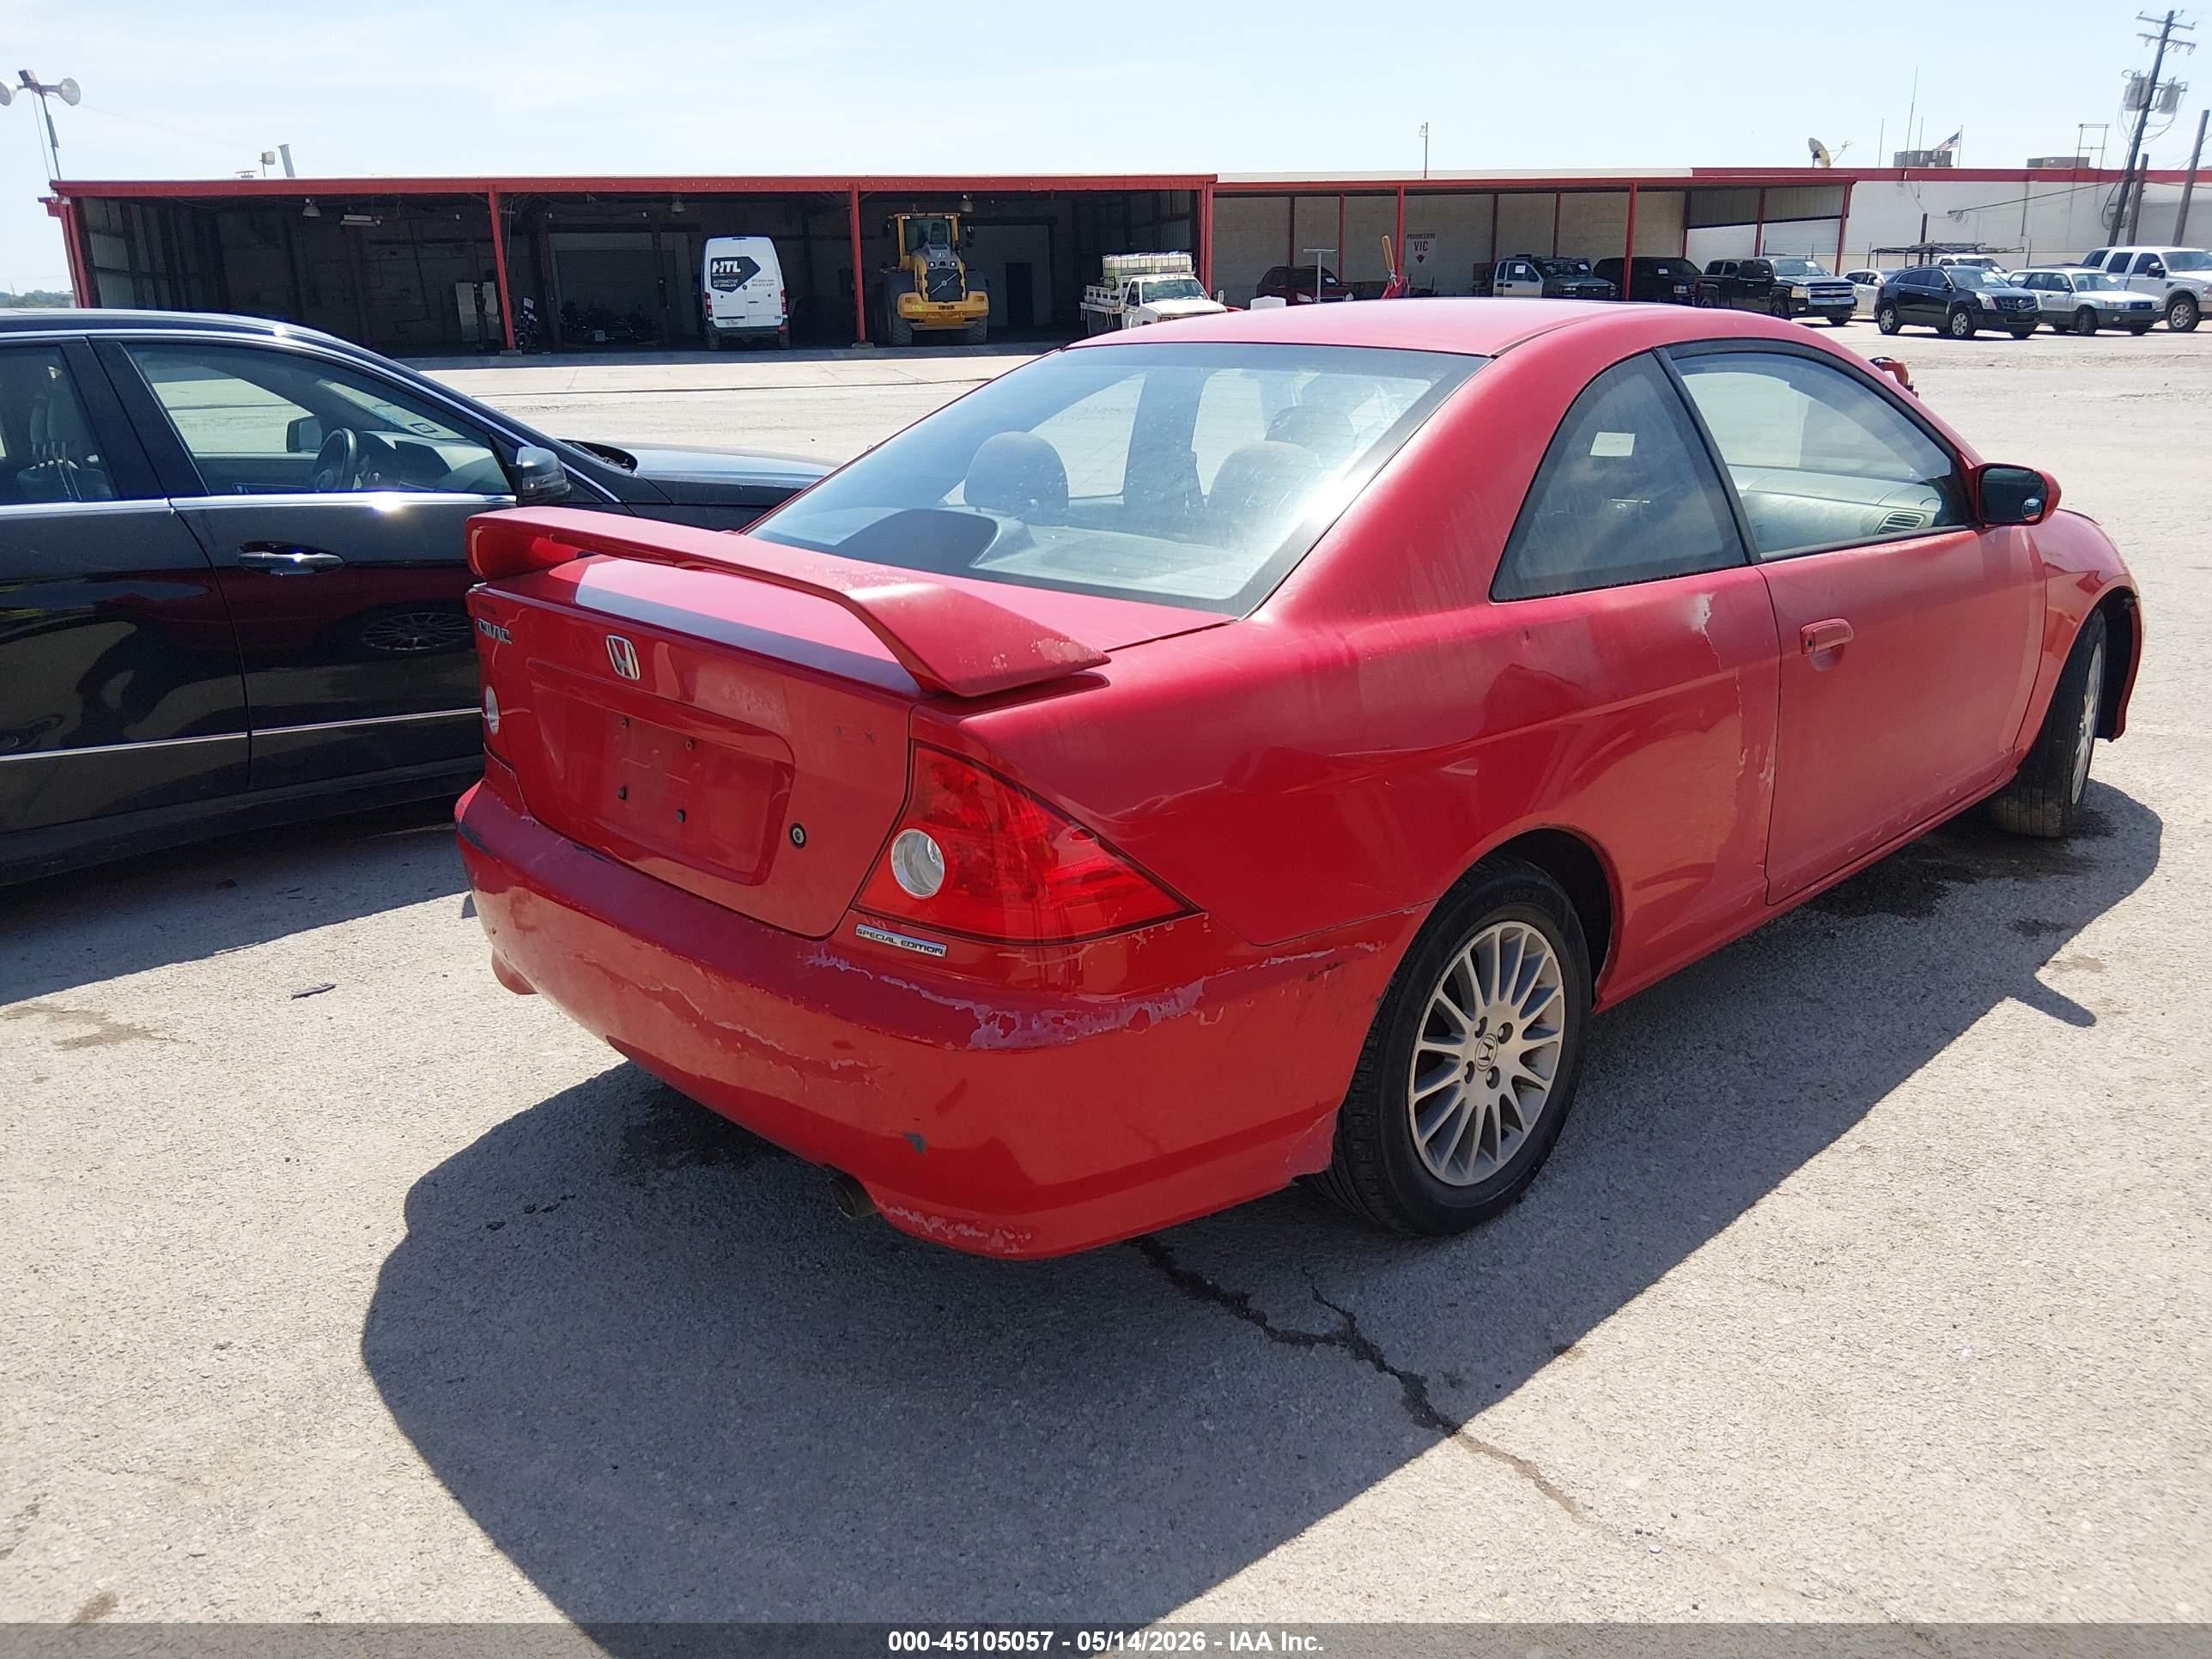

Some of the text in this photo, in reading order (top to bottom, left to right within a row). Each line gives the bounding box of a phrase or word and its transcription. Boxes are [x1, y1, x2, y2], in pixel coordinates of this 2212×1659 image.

[1413, 240, 1429, 252] VIC
[712, 260, 742, 273] HTL
[477, 617, 513, 645] CIVIC
[857, 927, 944, 956] SPECIAL EDITION
